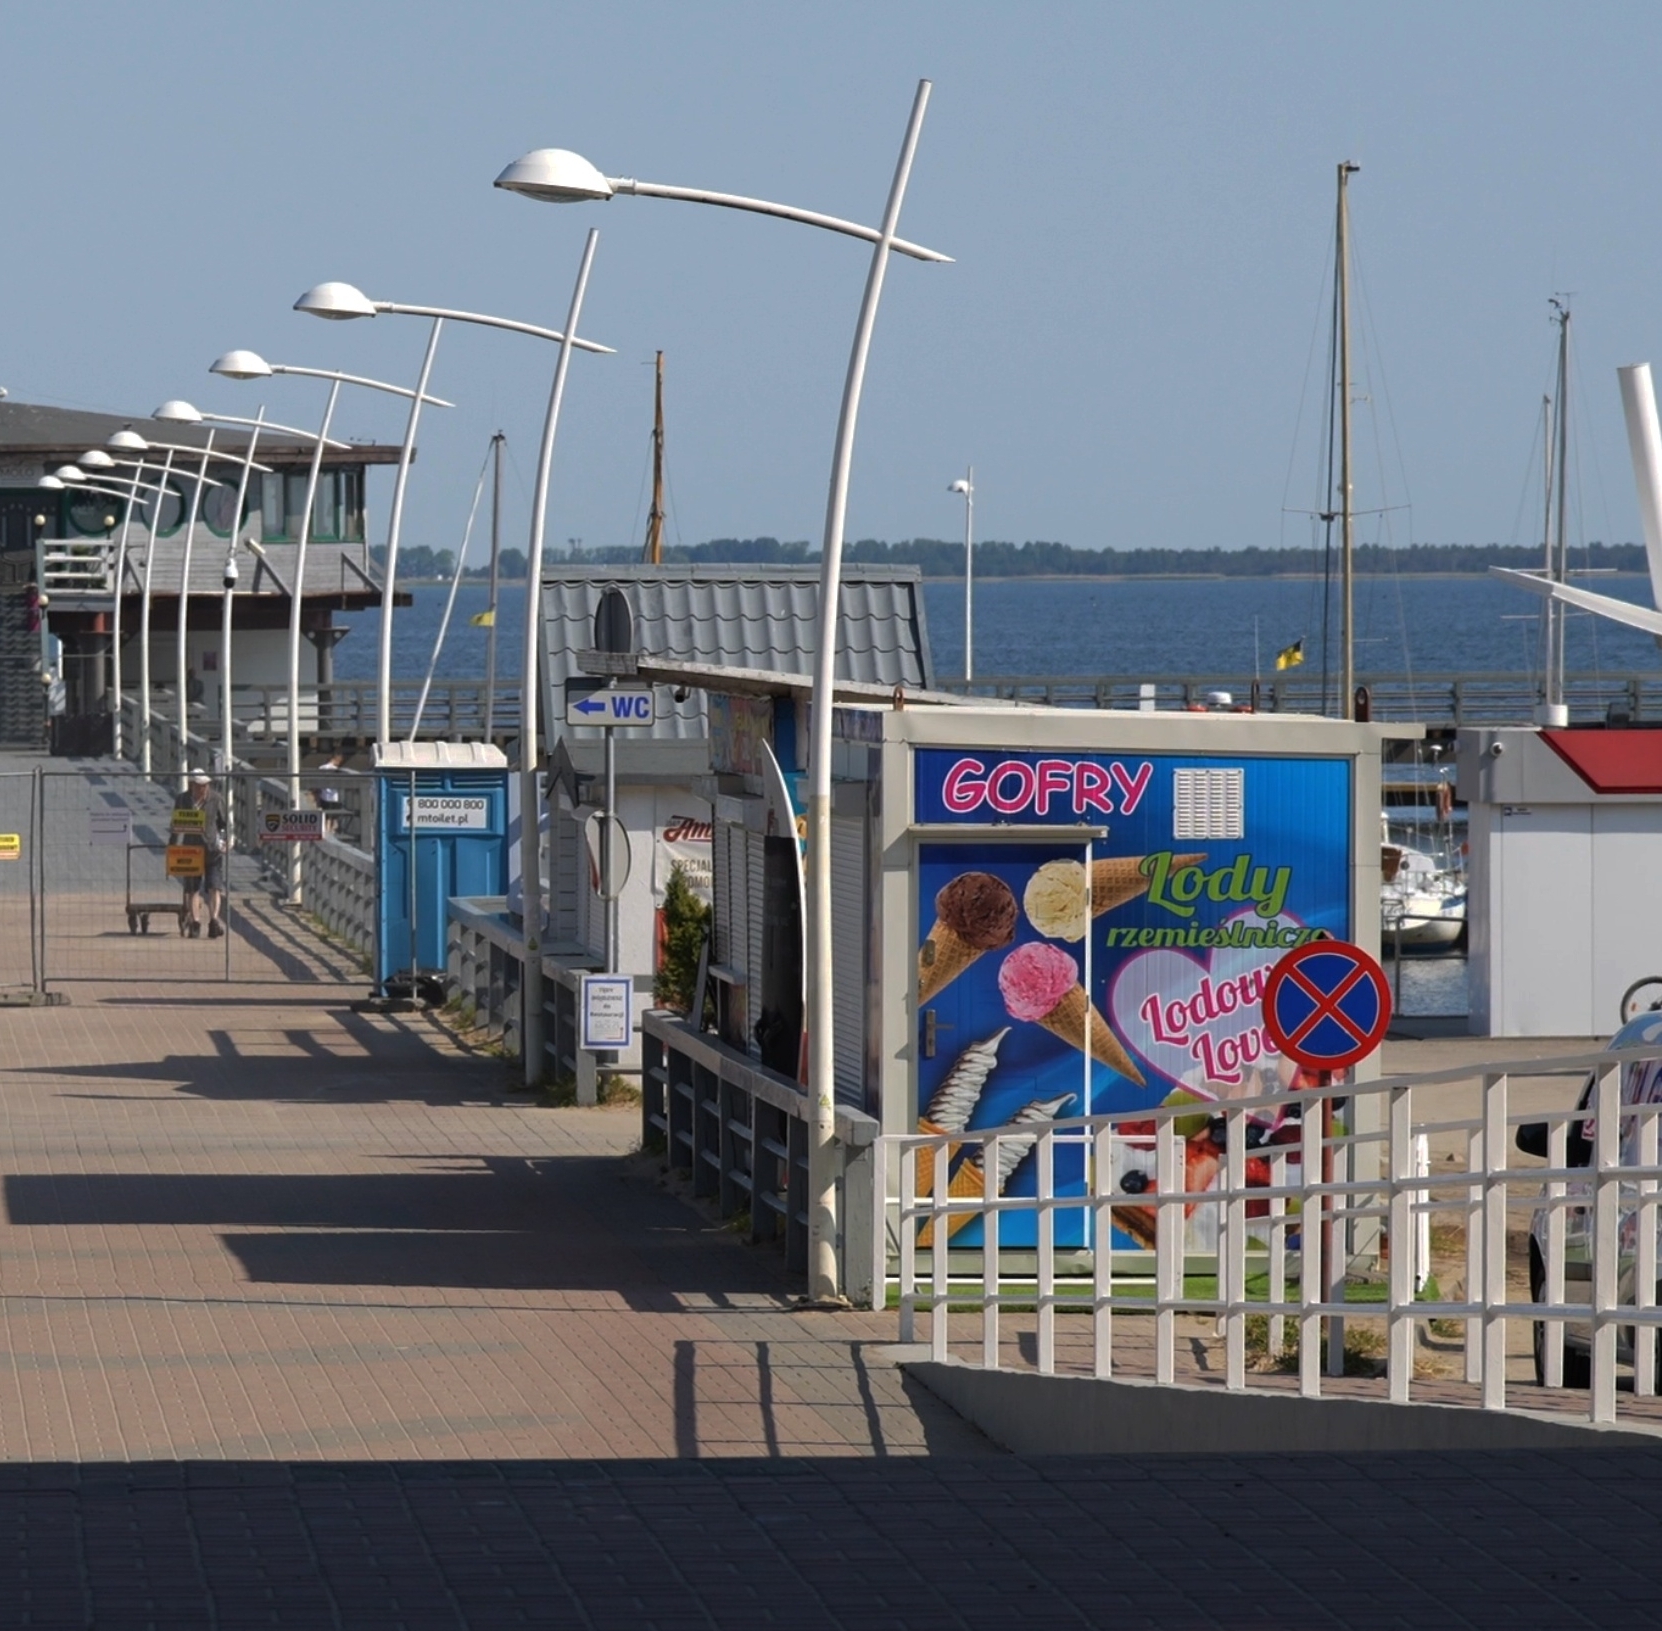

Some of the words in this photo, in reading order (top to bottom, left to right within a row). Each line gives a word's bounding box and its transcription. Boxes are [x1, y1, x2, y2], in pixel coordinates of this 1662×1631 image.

[611, 696, 650, 719] WC
[942, 757, 1153, 816] GOFRY
[418, 798, 439, 809] 800
[440, 799, 462, 810] 000
[463, 799, 485, 810] 800
[282, 813, 318, 824] SOLID
[417, 813, 469, 826] mtoilet.pl
[1139, 849, 1292, 918] Lody
